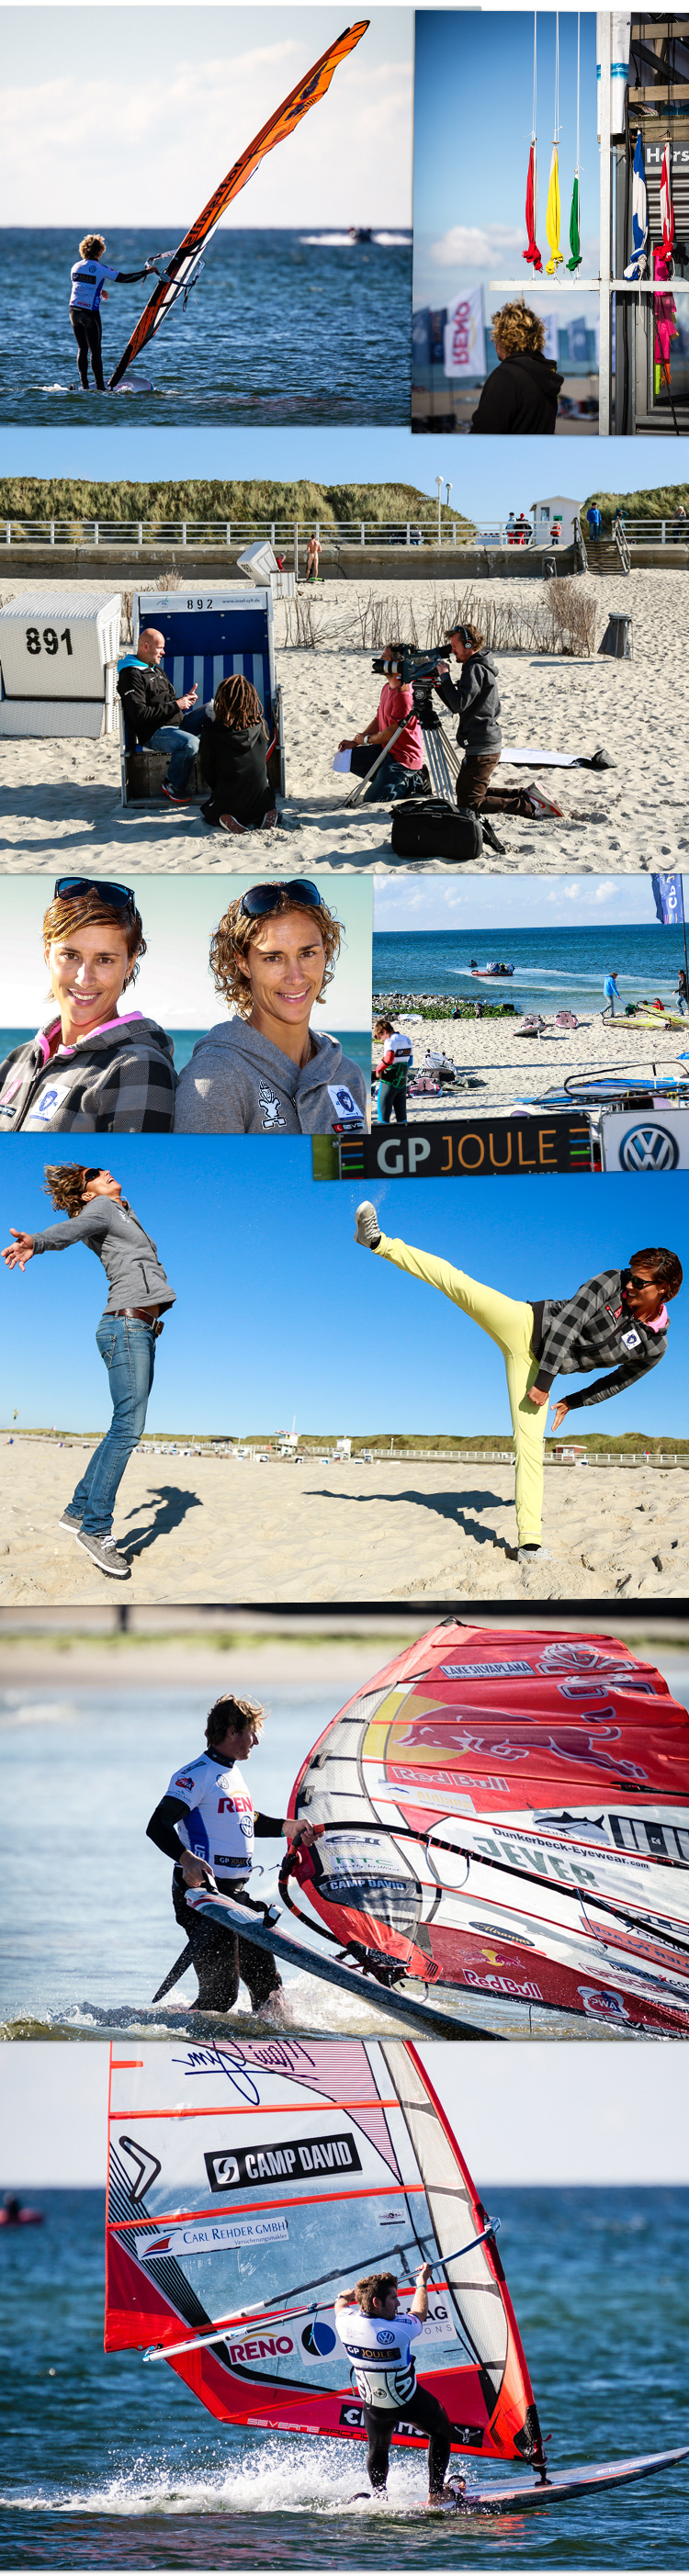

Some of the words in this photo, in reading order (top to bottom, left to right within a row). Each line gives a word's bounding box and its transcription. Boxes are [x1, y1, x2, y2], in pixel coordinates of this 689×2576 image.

[25, 626, 73, 656] 891
[377, 1137, 431, 1175] GP
[441, 1130, 558, 1171] JOULE
[441, 1665, 469, 1675] LAKE
[469, 1660, 533, 1673] SILVAPLANA
[391, 1767, 453, 1784] Red
[451, 1773, 510, 1792] Bull
[218, 1796, 253, 1814] REN
[492, 1828, 649, 1869] Dunkerbeck-Eyewear.com
[473, 1836, 600, 1888] JEVER
[331, 1880, 366, 1890] CAMP
[368, 1879, 404, 1891] DAVID
[462, 1969, 504, 1991] Red
[502, 1977, 543, 1999] Bull
[591, 1997, 618, 2010] PWA
[244, 2149, 297, 2179] CAMP
[298, 2141, 353, 2171] DAVID
[184, 2230, 209, 2244] CARL
[211, 2225, 254, 2240] REHDER
[255, 2222, 286, 2234] GMBH
[234, 2234, 288, 2245] Versicherungsmakler
[229, 2336, 294, 2364] RENO
[346, 2345, 360, 2355] GP
[361, 2348, 393, 2358] JOULE
